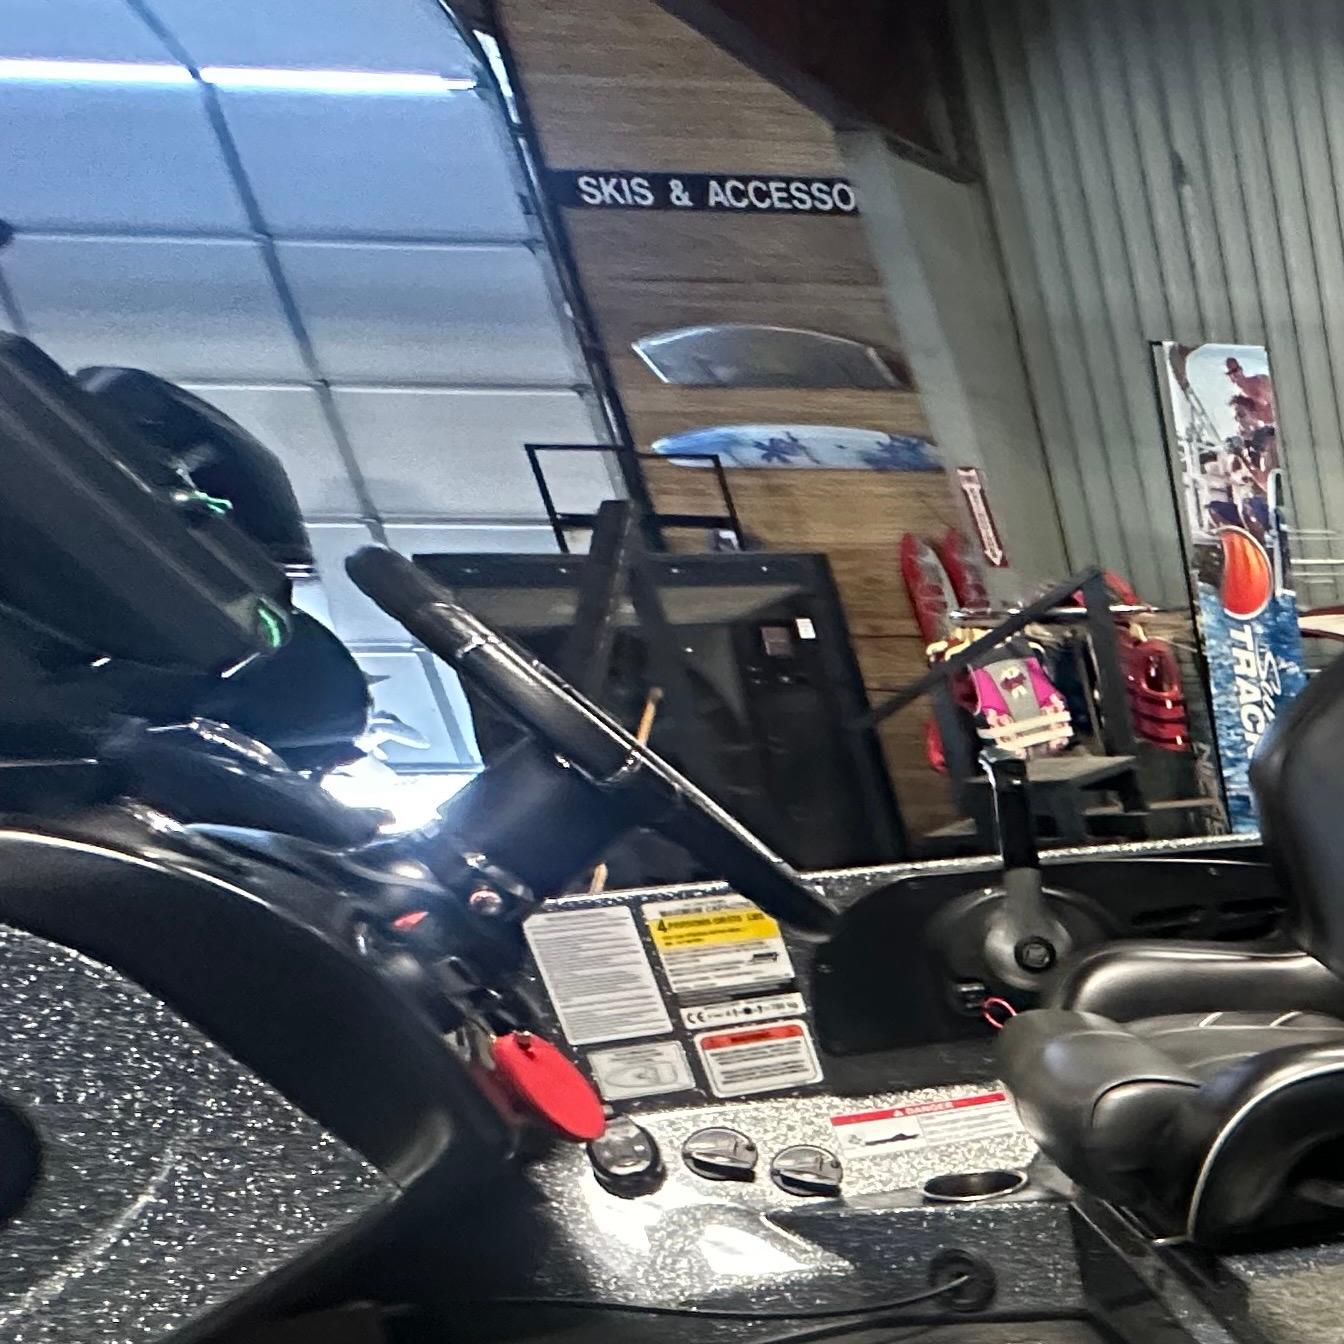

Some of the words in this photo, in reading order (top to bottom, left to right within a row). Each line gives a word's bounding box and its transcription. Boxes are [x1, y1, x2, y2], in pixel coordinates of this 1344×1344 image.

[577, 175, 655, 206] SKIS
[669, 178, 694, 207] &
[708, 180, 857, 212] ACCESSO
